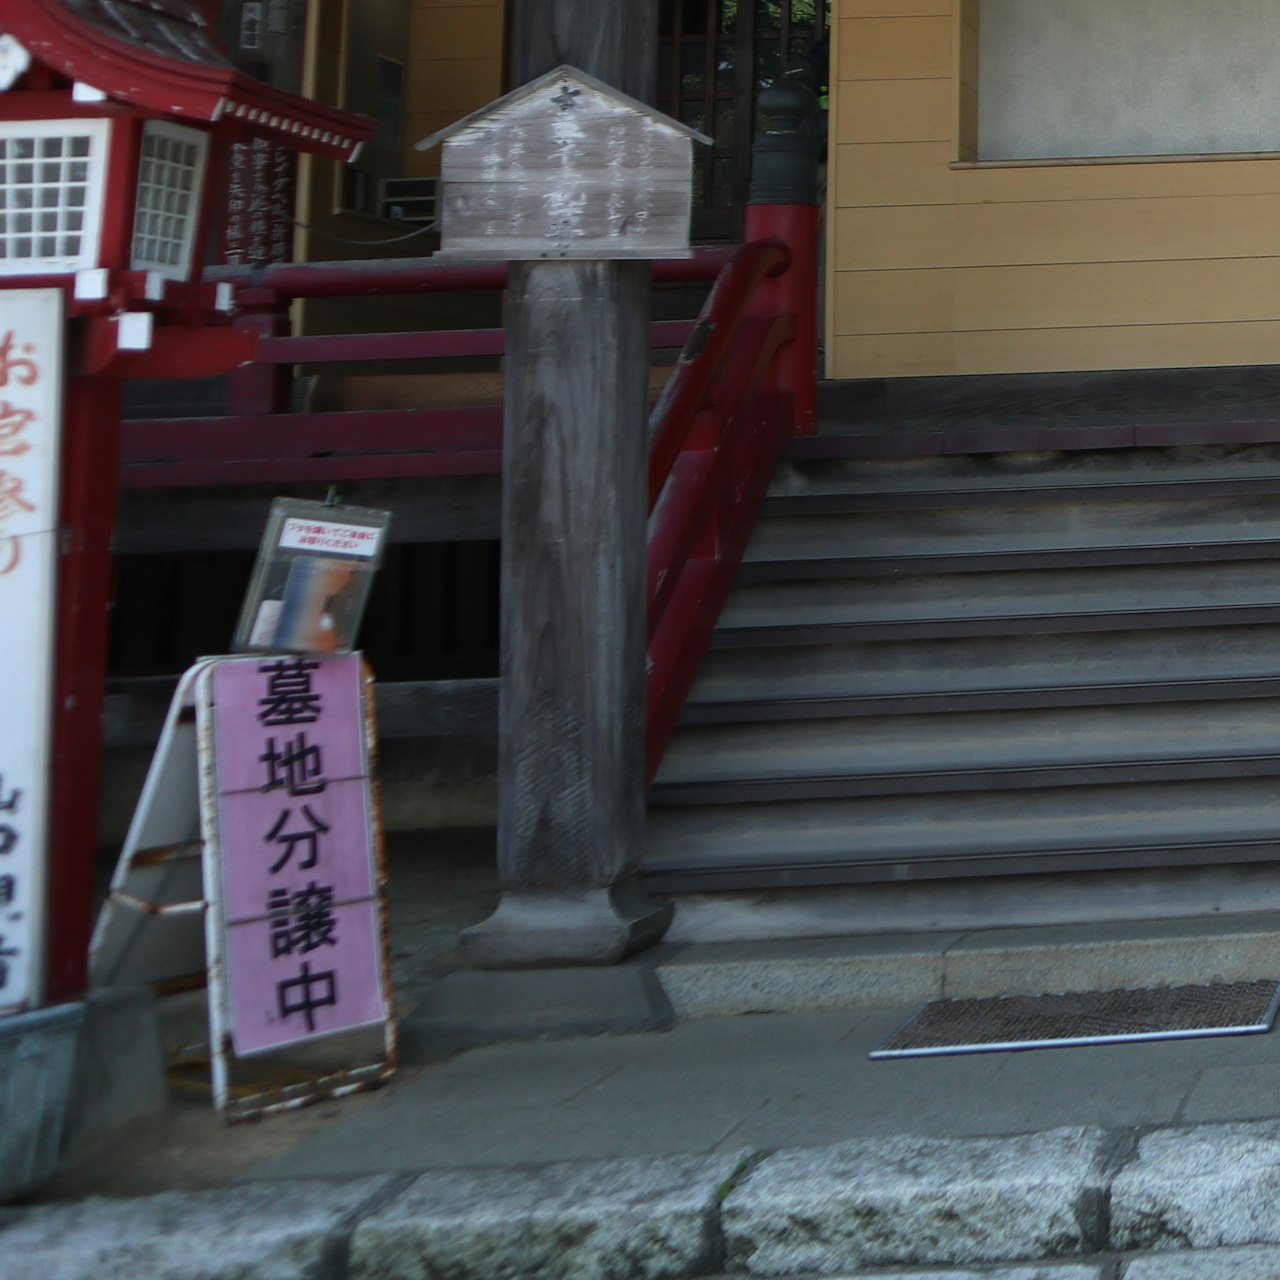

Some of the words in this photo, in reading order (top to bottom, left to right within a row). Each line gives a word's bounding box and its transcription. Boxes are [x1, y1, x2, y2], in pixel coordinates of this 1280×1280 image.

[256, 657, 339, 1034] 墓地分譲中
